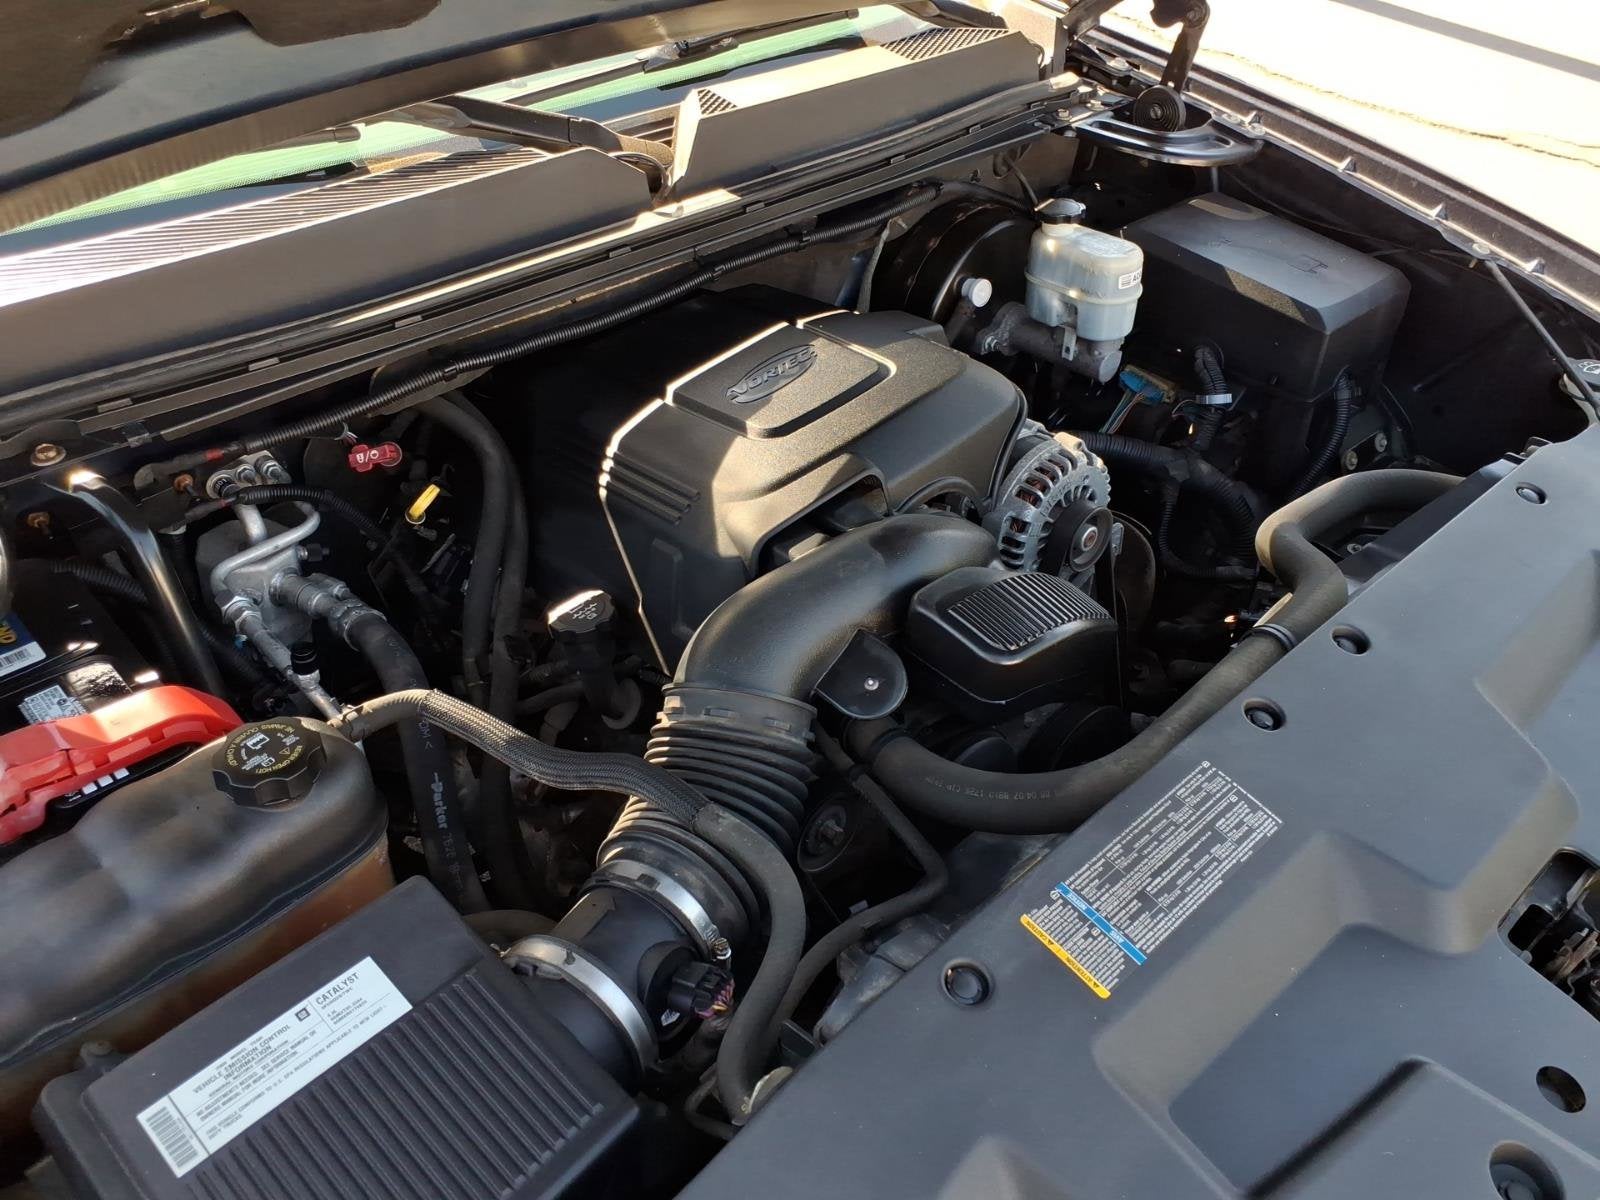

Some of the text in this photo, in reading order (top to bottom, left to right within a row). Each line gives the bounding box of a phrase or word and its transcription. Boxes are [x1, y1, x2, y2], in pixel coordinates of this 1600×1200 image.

[726, 346, 817, 400] VORTEC
[316, 971, 361, 1005] CATALYST
[192, 1023, 291, 1094] VEHICLE EMISSION CONTROL
[222, 1044, 272, 1080] INFORMATION
